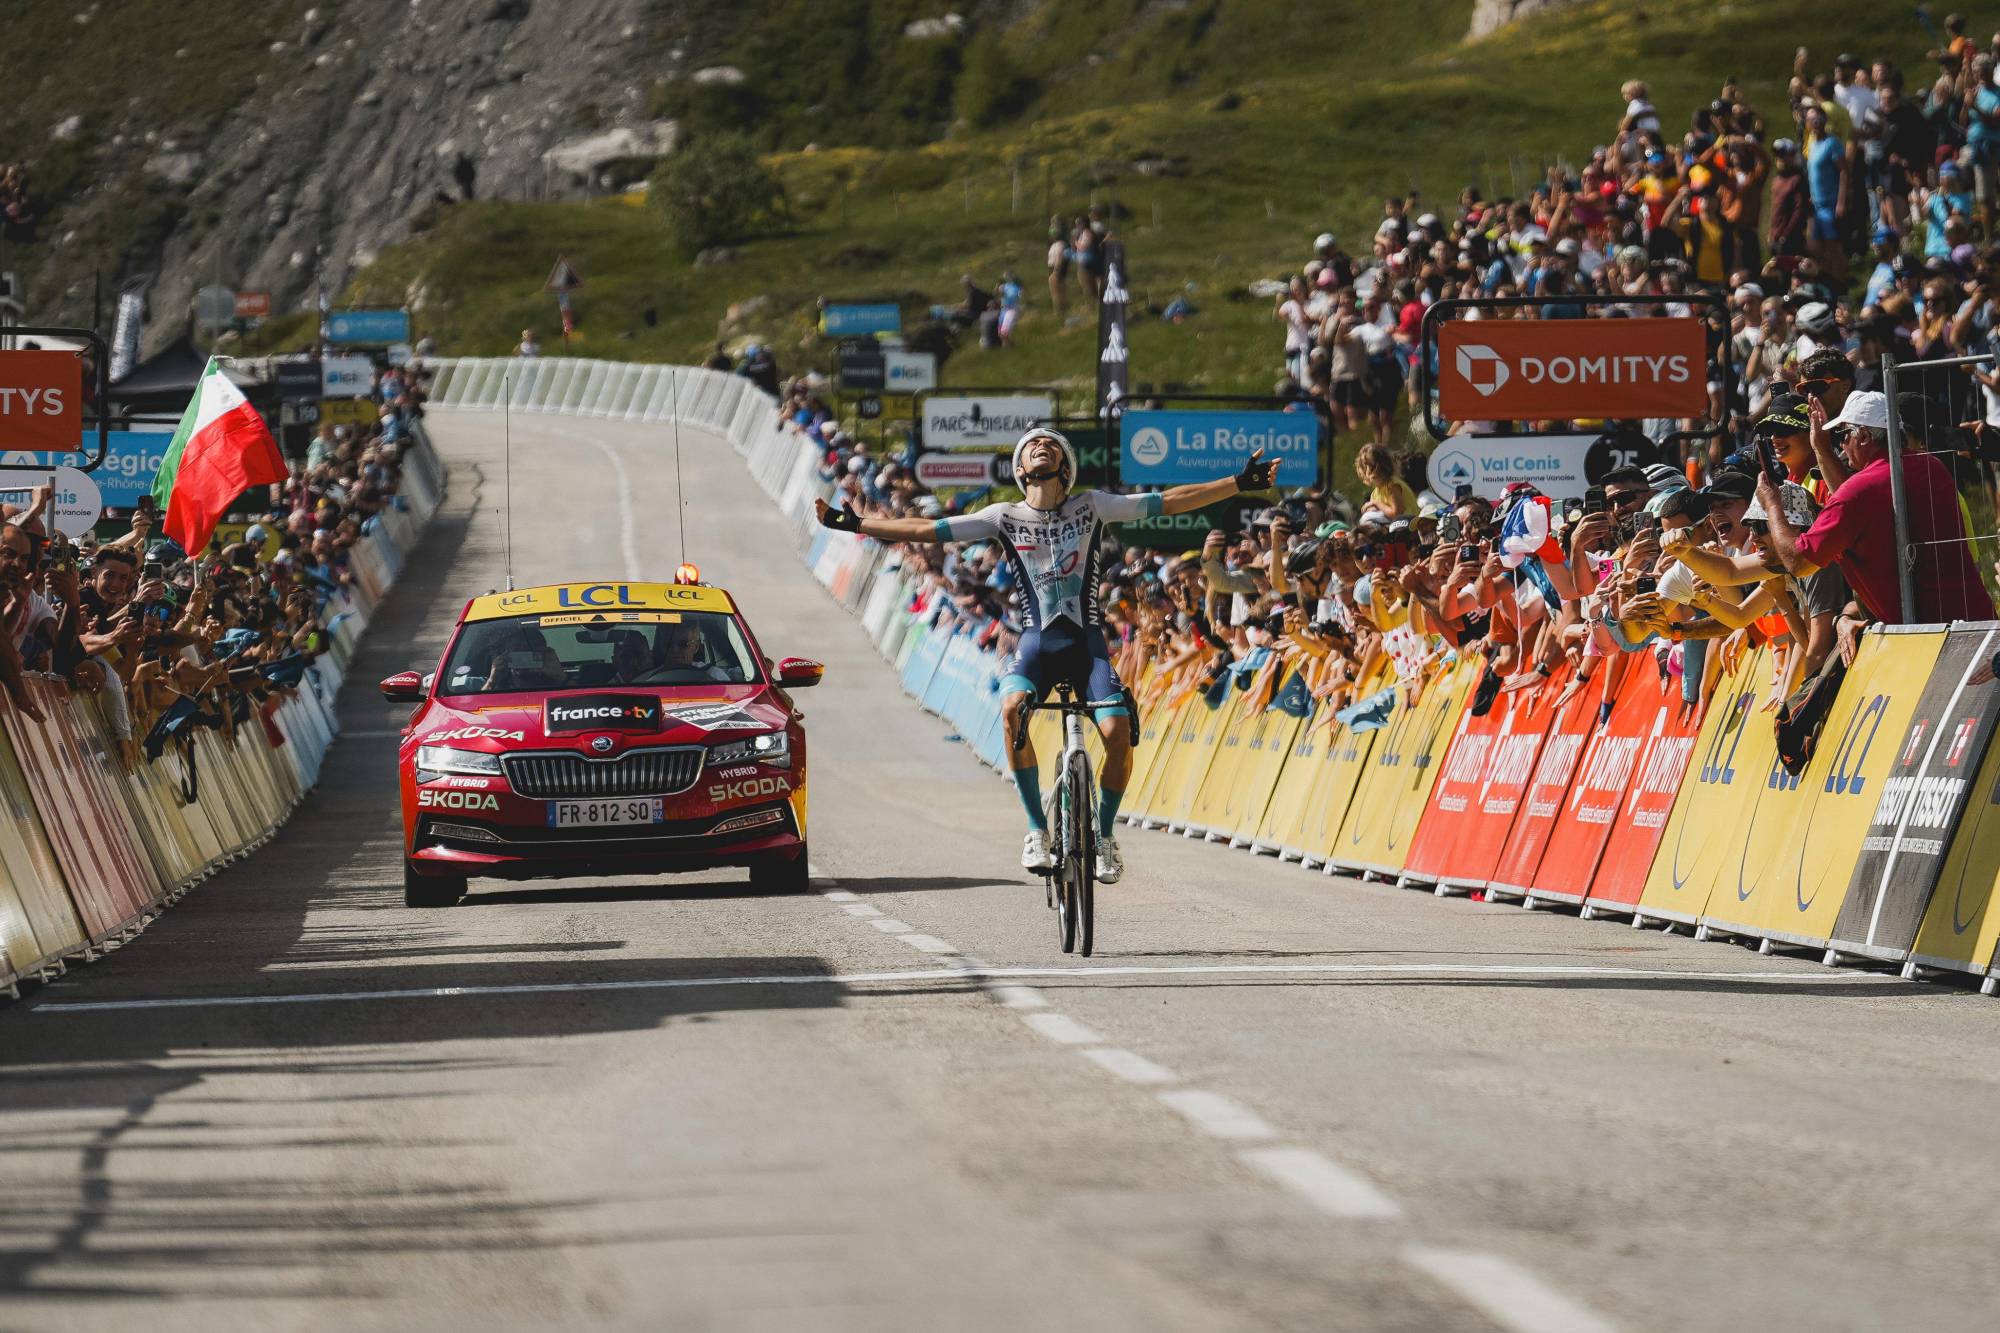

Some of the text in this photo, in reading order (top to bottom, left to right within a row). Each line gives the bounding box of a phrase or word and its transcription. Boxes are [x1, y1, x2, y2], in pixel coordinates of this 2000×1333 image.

[1520, 355, 1690, 384] DOMITYS
[931, 416, 968, 432] PARC
[1176, 426, 1310, 452] La Région
[1481, 455, 1561, 471] Val Cenis
[1608, 450, 1638, 471] 25
[1002, 511, 1093, 538] BAHRAIN
[1009, 524, 1091, 546] VICTORIOUS
[558, 585, 647, 608] LCL
[667, 589, 704, 600] LCL
[1010, 558, 1034, 628] BAHRAIN
[1089, 549, 1100, 626] BAHRAIN
[503, 594, 538, 606] LCL
[422, 726, 525, 745] SKODA
[1700, 692, 1756, 784] LCL
[1824, 694, 1891, 794] LCL
[450, 778, 489, 788] HYBRID
[719, 766, 758, 779] HYBRID
[709, 776, 791, 802] SKODA
[418, 790, 500, 811] SKODA
[1909, 776, 1967, 829] TISSOT
[559, 802, 649, 823] FR-812-SQ
[653, 810, 663, 818] 92
